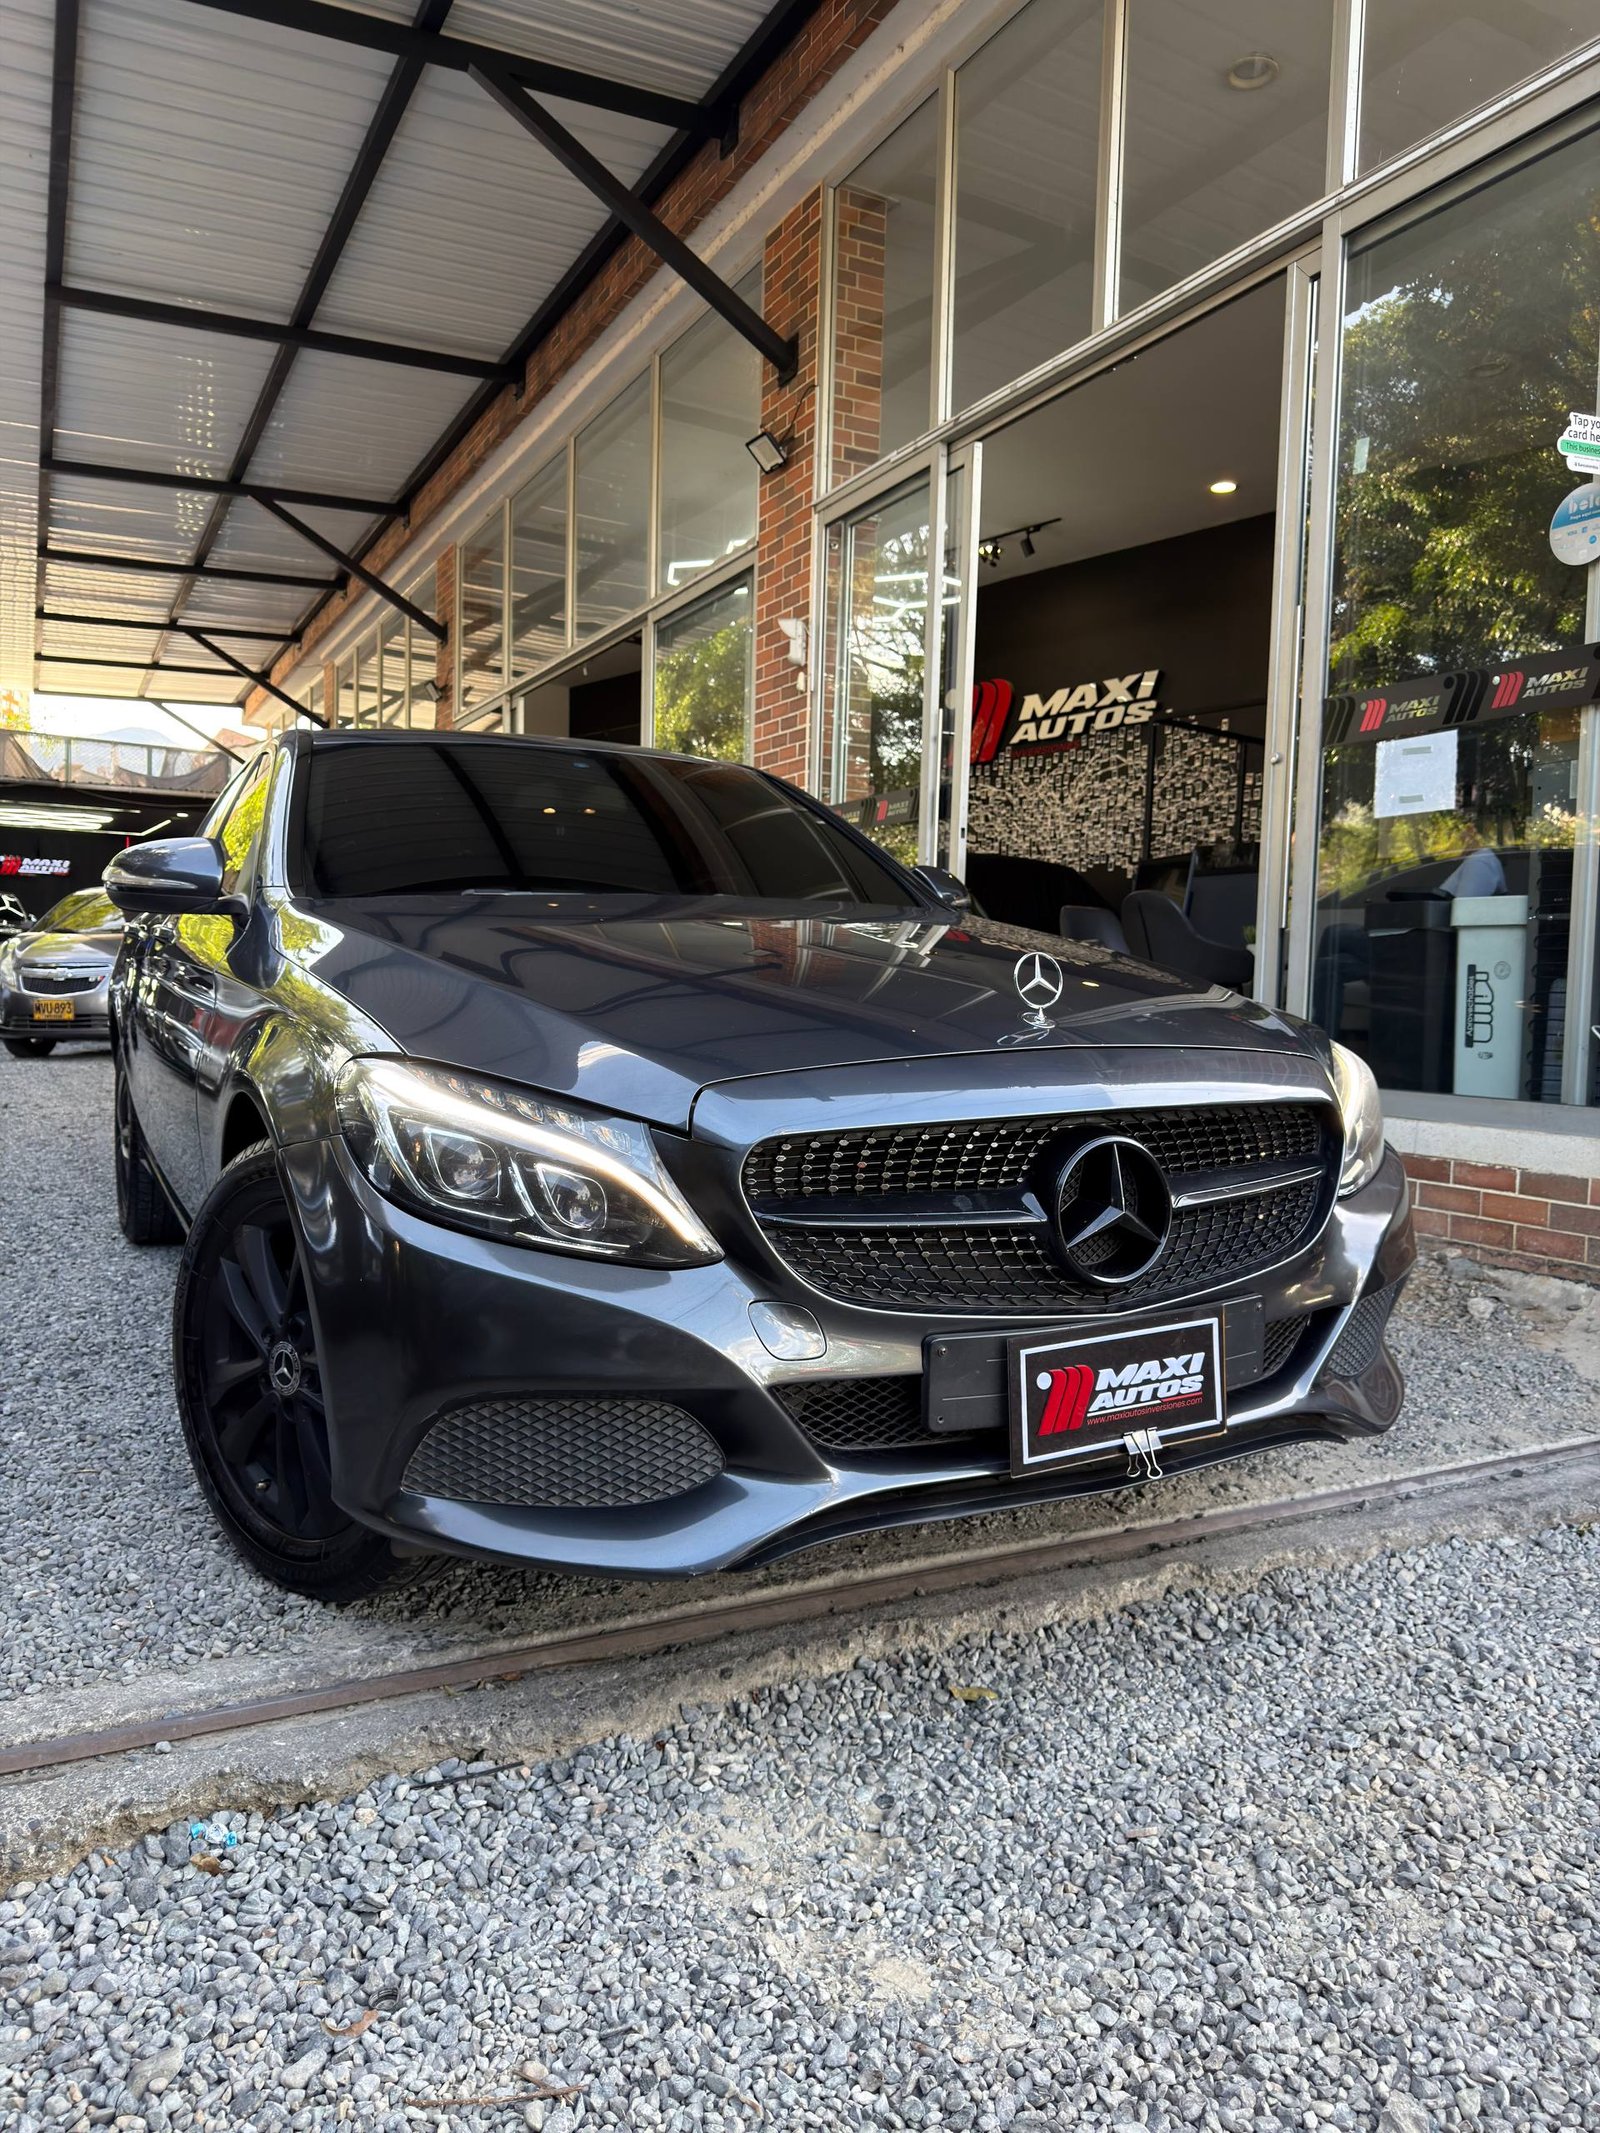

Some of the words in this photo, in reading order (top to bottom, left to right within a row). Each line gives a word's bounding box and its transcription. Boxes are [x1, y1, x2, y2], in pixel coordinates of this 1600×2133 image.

[1573, 414, 1589, 429] Tap
[1568, 429, 1588, 440] card
[1566, 442, 1578, 451] This
[1526, 667, 1588, 688] MAXI
[1019, 669, 1160, 721] MAXI
[1521, 678, 1587, 699] AUTOS
[1385, 705, 1439, 723] AUTOS
[1389, 695, 1439, 714] MAXI
[1009, 699, 1157, 745] AUTOS
[22, 857, 70, 868] MAXI
[1095, 1352, 1206, 1391] MAXI
[1088, 1375, 1204, 1412] AUTOS
[1086, 1397, 1203, 1426] www.maxiautosinversiones.com
